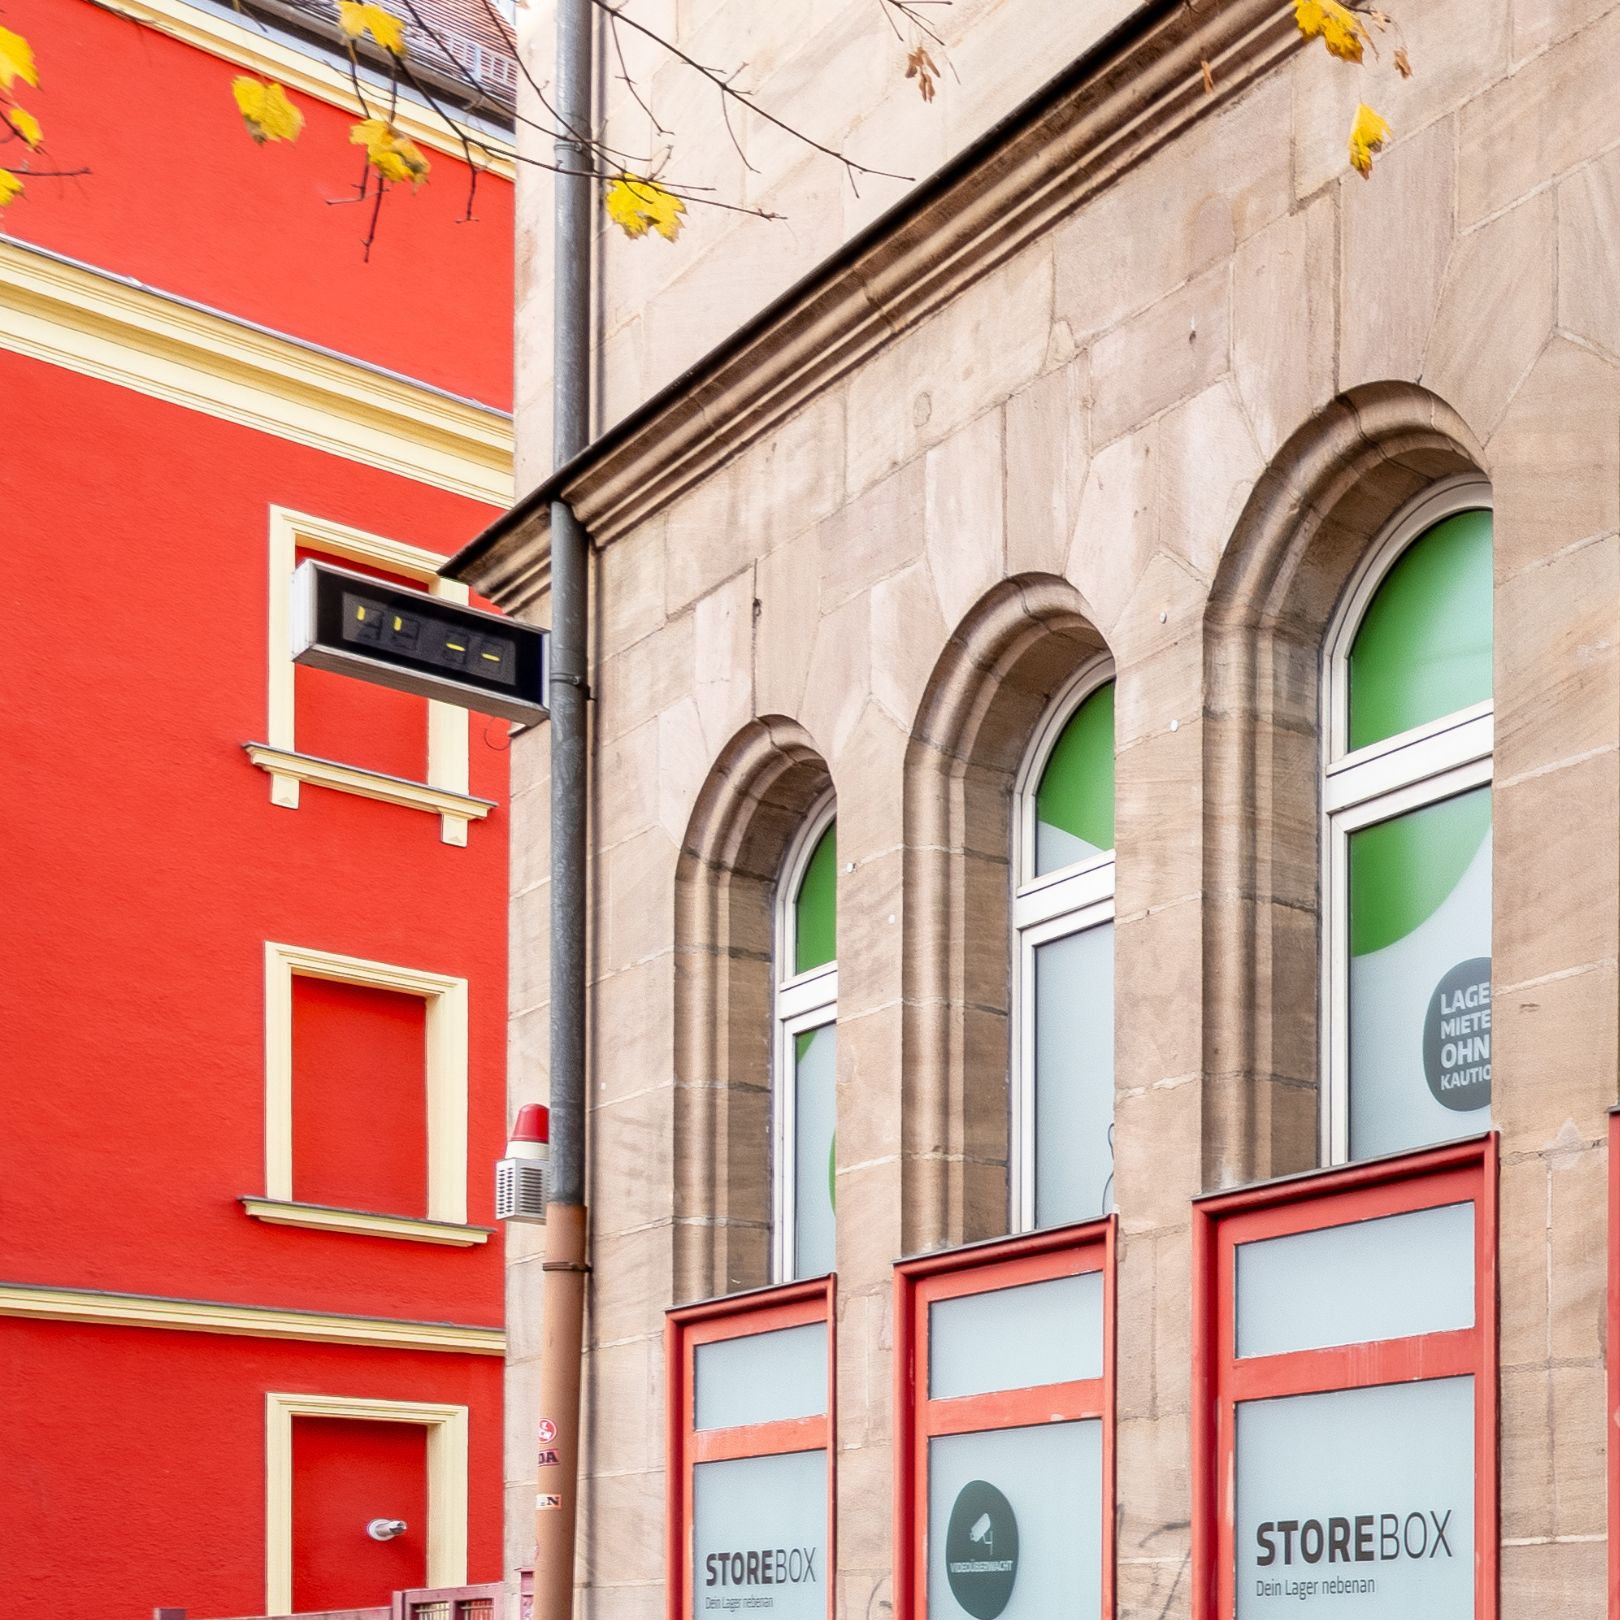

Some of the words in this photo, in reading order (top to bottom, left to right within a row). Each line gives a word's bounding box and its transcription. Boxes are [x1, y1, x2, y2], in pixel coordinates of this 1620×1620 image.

[1255, 1508, 1453, 1567] STOREBOX
[705, 1547, 816, 1587] STOREBOX
[1256, 1578, 1280, 1597] Dein
[1285, 1578, 1317, 1601] Lager
[1321, 1576, 1375, 1595] nebenan
